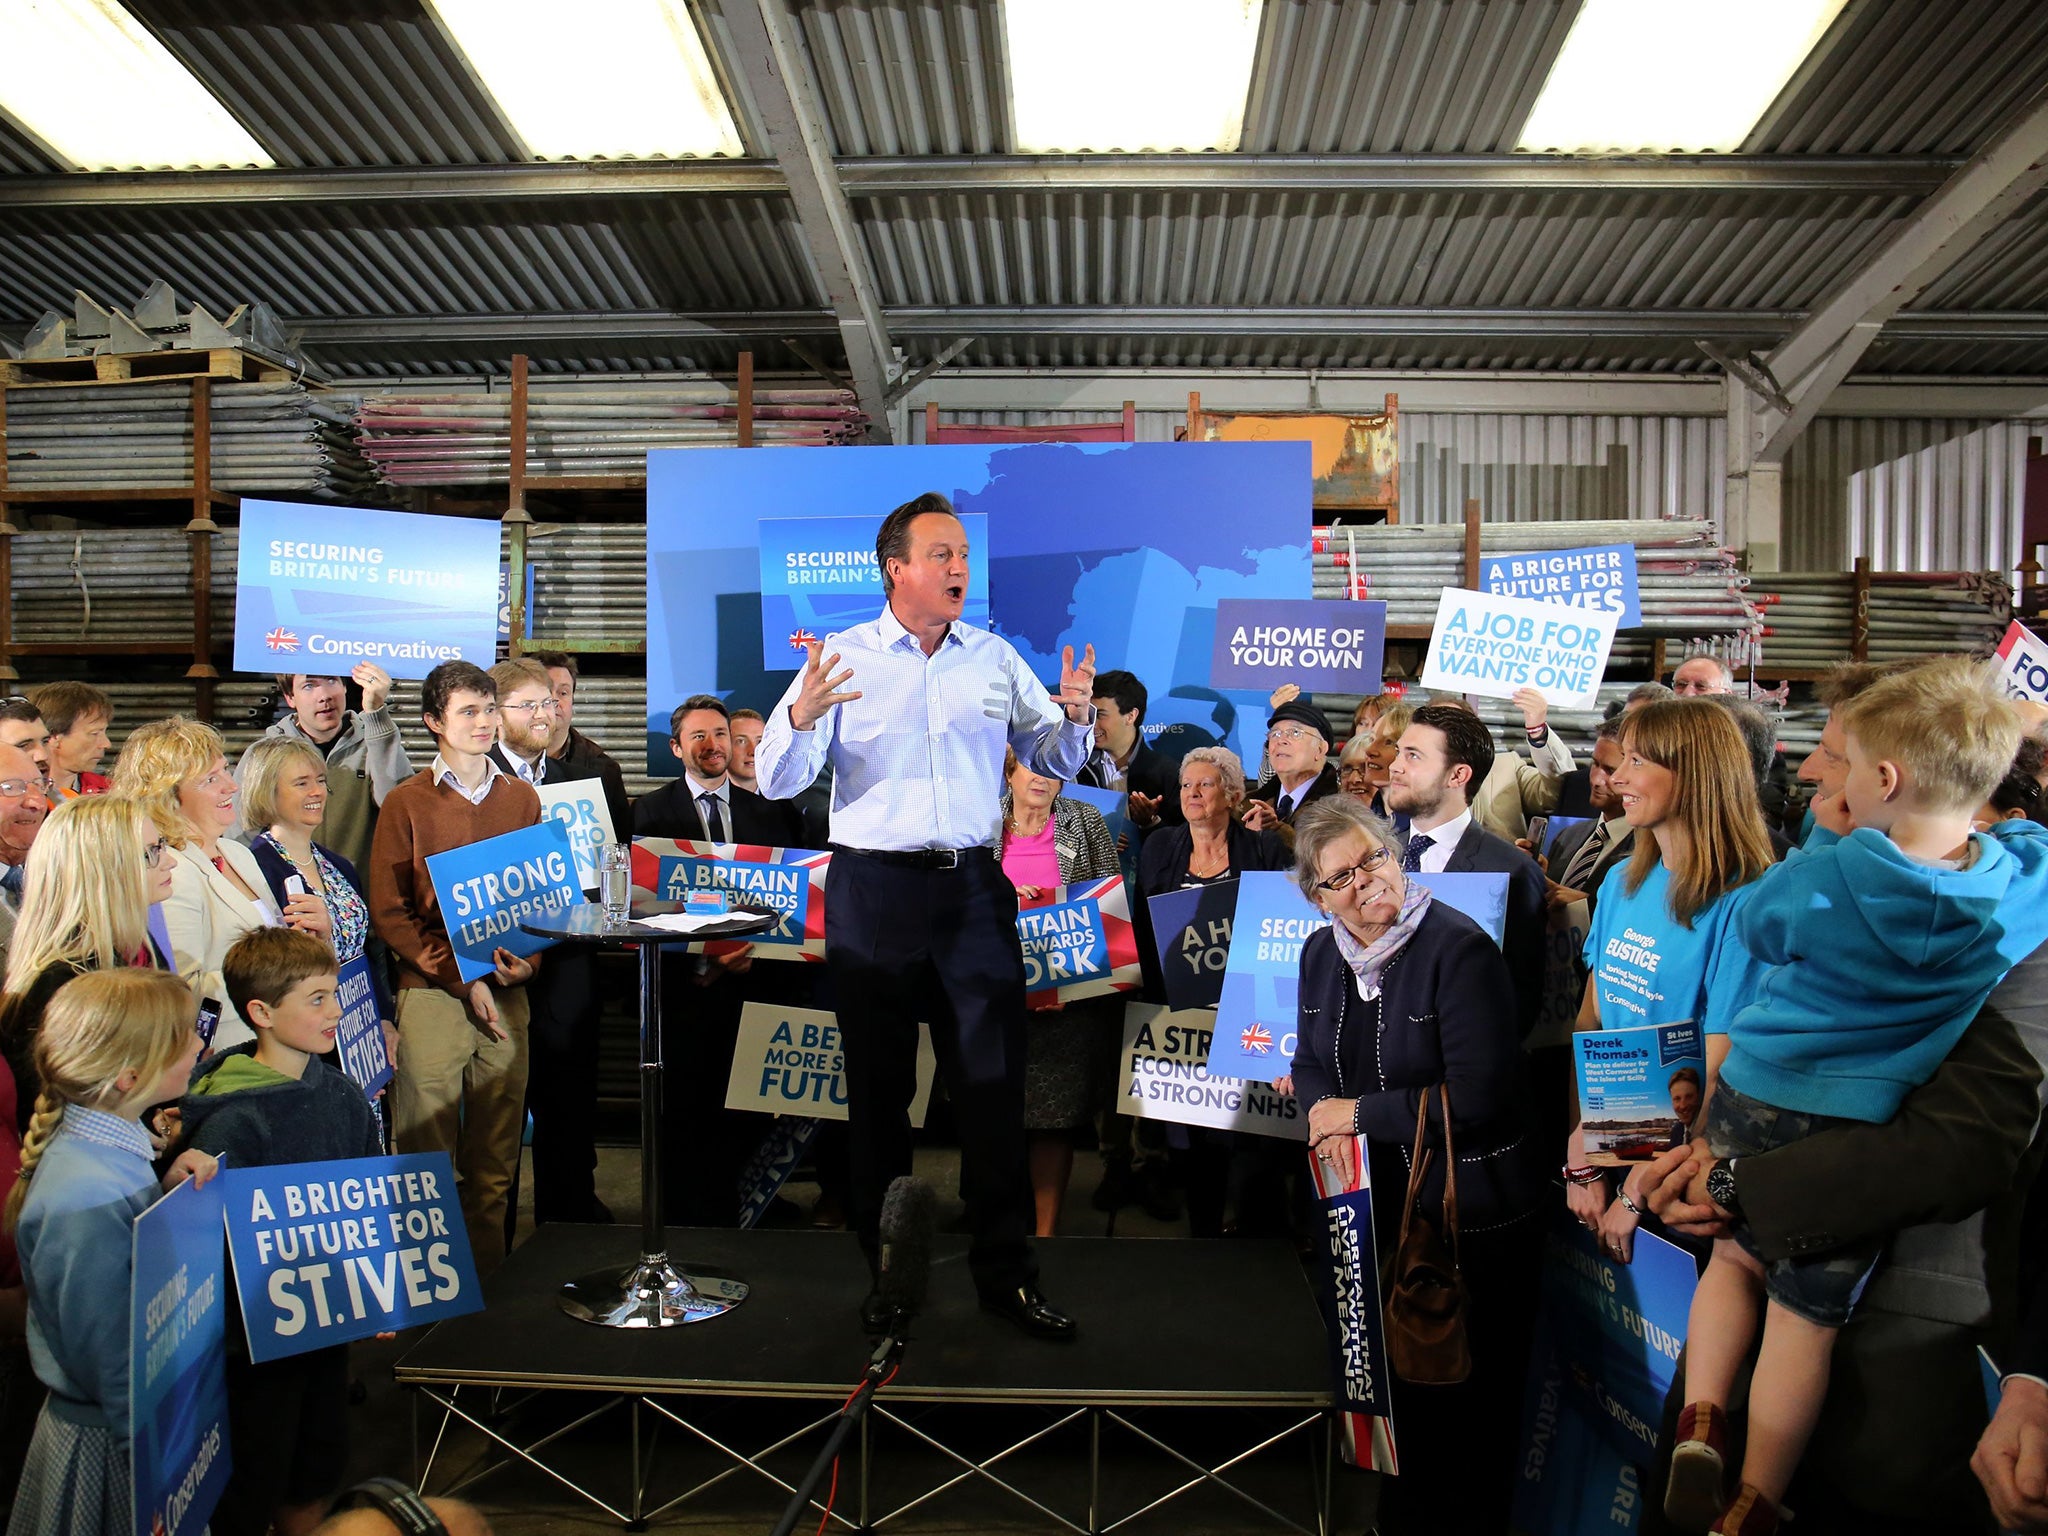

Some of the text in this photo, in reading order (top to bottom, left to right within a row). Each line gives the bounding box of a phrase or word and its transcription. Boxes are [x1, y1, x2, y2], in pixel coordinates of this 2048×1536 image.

[270, 540, 383, 564] SECURING
[1489, 552, 1622, 580] A BRIGHTER
[269, 560, 380, 583] BRITAIN'S
[1491, 571, 1624, 597] FUTURE FOR
[308, 634, 462, 660] Conservatives
[1230, 626, 1365, 649] A HOME OF
[1445, 608, 1601, 653] A JOB FOR
[1229, 646, 1363, 670] YOUR OWN
[1440, 634, 1597, 671] EVERYONE WHO
[1437, 652, 1592, 693] WANTS ONE
[2012, 651, 2048, 702] FO
[568, 826, 606, 848] HO
[451, 851, 567, 917] STRONG
[668, 863, 799, 893] A BRITAIN
[1020, 928, 1096, 956] EWARDS
[1182, 926, 1199, 951] A
[1257, 942, 1303, 963] BRIT
[1623, 927, 1656, 948] George
[1022, 944, 1101, 987] ORK
[1605, 937, 1662, 973] EUSTICE
[337, 970, 371, 1009] BRIGHTER
[339, 1007, 365, 1045] FUTURE
[363, 998, 377, 1028] FOR
[769, 1021, 793, 1046] A
[1134, 1023, 1156, 1051] A
[1667, 1030, 1694, 1039] St Ives
[764, 1048, 828, 1070] MORE
[1583, 1038, 1624, 1049] Derek
[1584, 1048, 1649, 1060] Thomas's
[759, 1067, 850, 1106] FUTU
[1128, 1078, 1298, 1120] A STRONG NHS
[251, 1171, 442, 1223] A BRIGHTER
[255, 1207, 450, 1266] FUTURE FOR
[267, 1242, 461, 1337] ST.IVES
[1327, 1208, 1358, 1401] ITS MEANS
[1337, 1206, 1367, 1402] LIVES WITHIN
[1346, 1204, 1375, 1404] A BRITAIN THAT
[1595, 1381, 1659, 1449] Conserv
[166, 1421, 221, 1535] Conservatives
